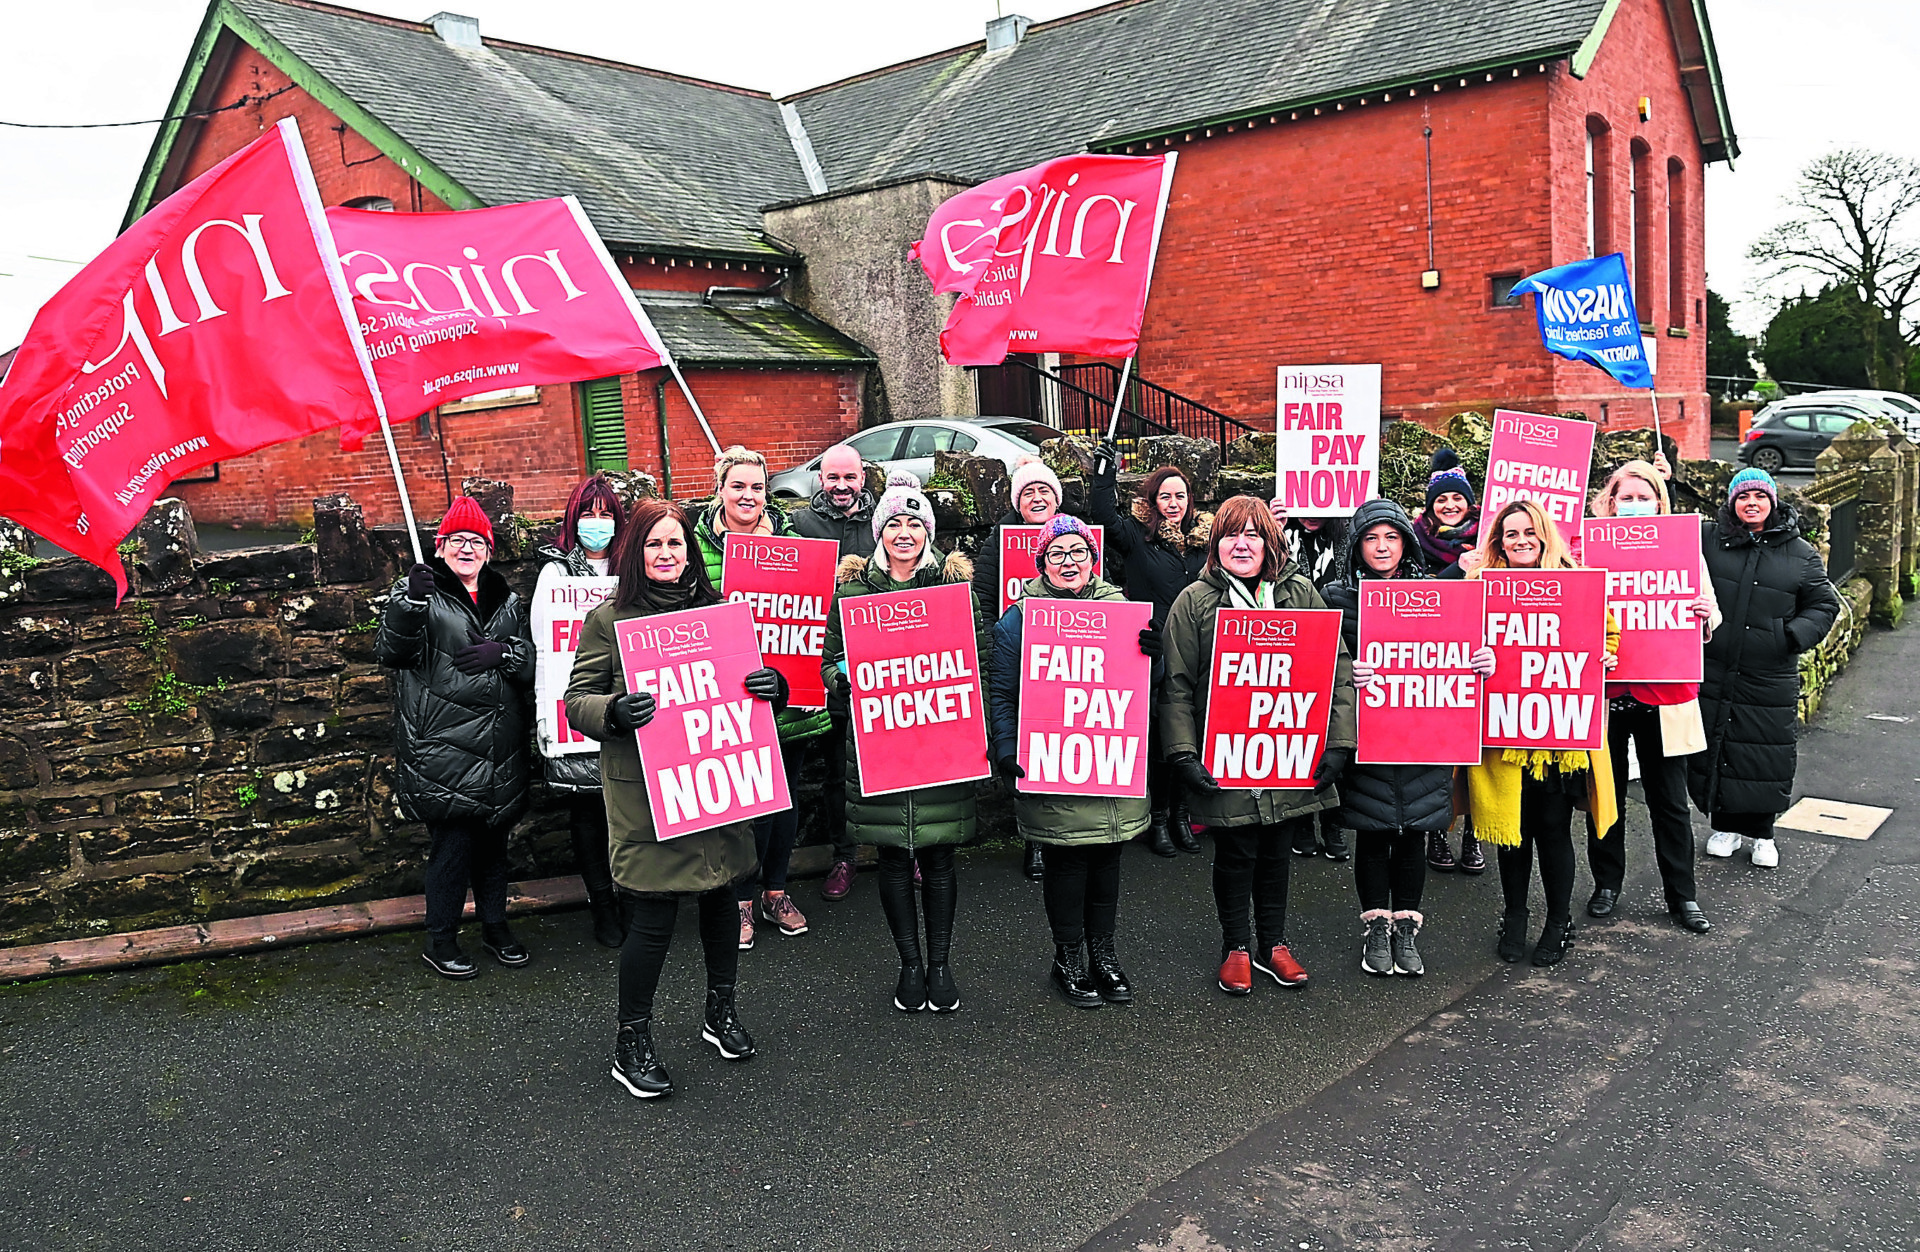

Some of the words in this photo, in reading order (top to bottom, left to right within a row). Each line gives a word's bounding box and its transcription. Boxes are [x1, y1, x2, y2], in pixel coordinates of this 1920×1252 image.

[1284, 372, 1344, 395] nipsa
[1284, 402, 1343, 431] FAIR
[1499, 418, 1559, 442] nipsa
[1311, 434, 1366, 466] PAY
[1285, 470, 1371, 508] NOW
[1493, 459, 1582, 493] OFFICIAL
[1007, 532, 1040, 557] nip
[1589, 523, 1659, 550] nipsa
[731, 540, 800, 569] nipsa
[1487, 576, 1562, 606] nipsa
[1608, 569, 1695, 596] FFICIAL
[849, 598, 928, 633] nipsa
[1366, 586, 1441, 617] nipsa
[1608, 599, 1696, 631] TRIKE
[552, 619, 585, 652] FA
[1030, 605, 1108, 637] nipsa
[1222, 615, 1298, 646] nipsa
[1487, 612, 1561, 647] FAIR
[625, 620, 710, 658] nipsa
[754, 622, 826, 656] RIKE
[1365, 641, 1472, 669] OFFICIAL
[856, 648, 973, 692] OFFICIAL
[1029, 644, 1105, 683] FAIR
[1218, 652, 1293, 687] FAIR
[1520, 651, 1590, 689] PAY
[634, 659, 721, 710] FAIR
[1364, 674, 1476, 708] STRIKE
[859, 682, 975, 734] PICKET
[1063, 687, 1134, 730] PAY
[1248, 691, 1318, 729] PAY
[1487, 692, 1596, 741] NOW
[681, 698, 754, 756] PAY
[1027, 731, 1140, 787] NOW
[1211, 732, 1320, 780] NOW
[657, 745, 775, 826] NOW
